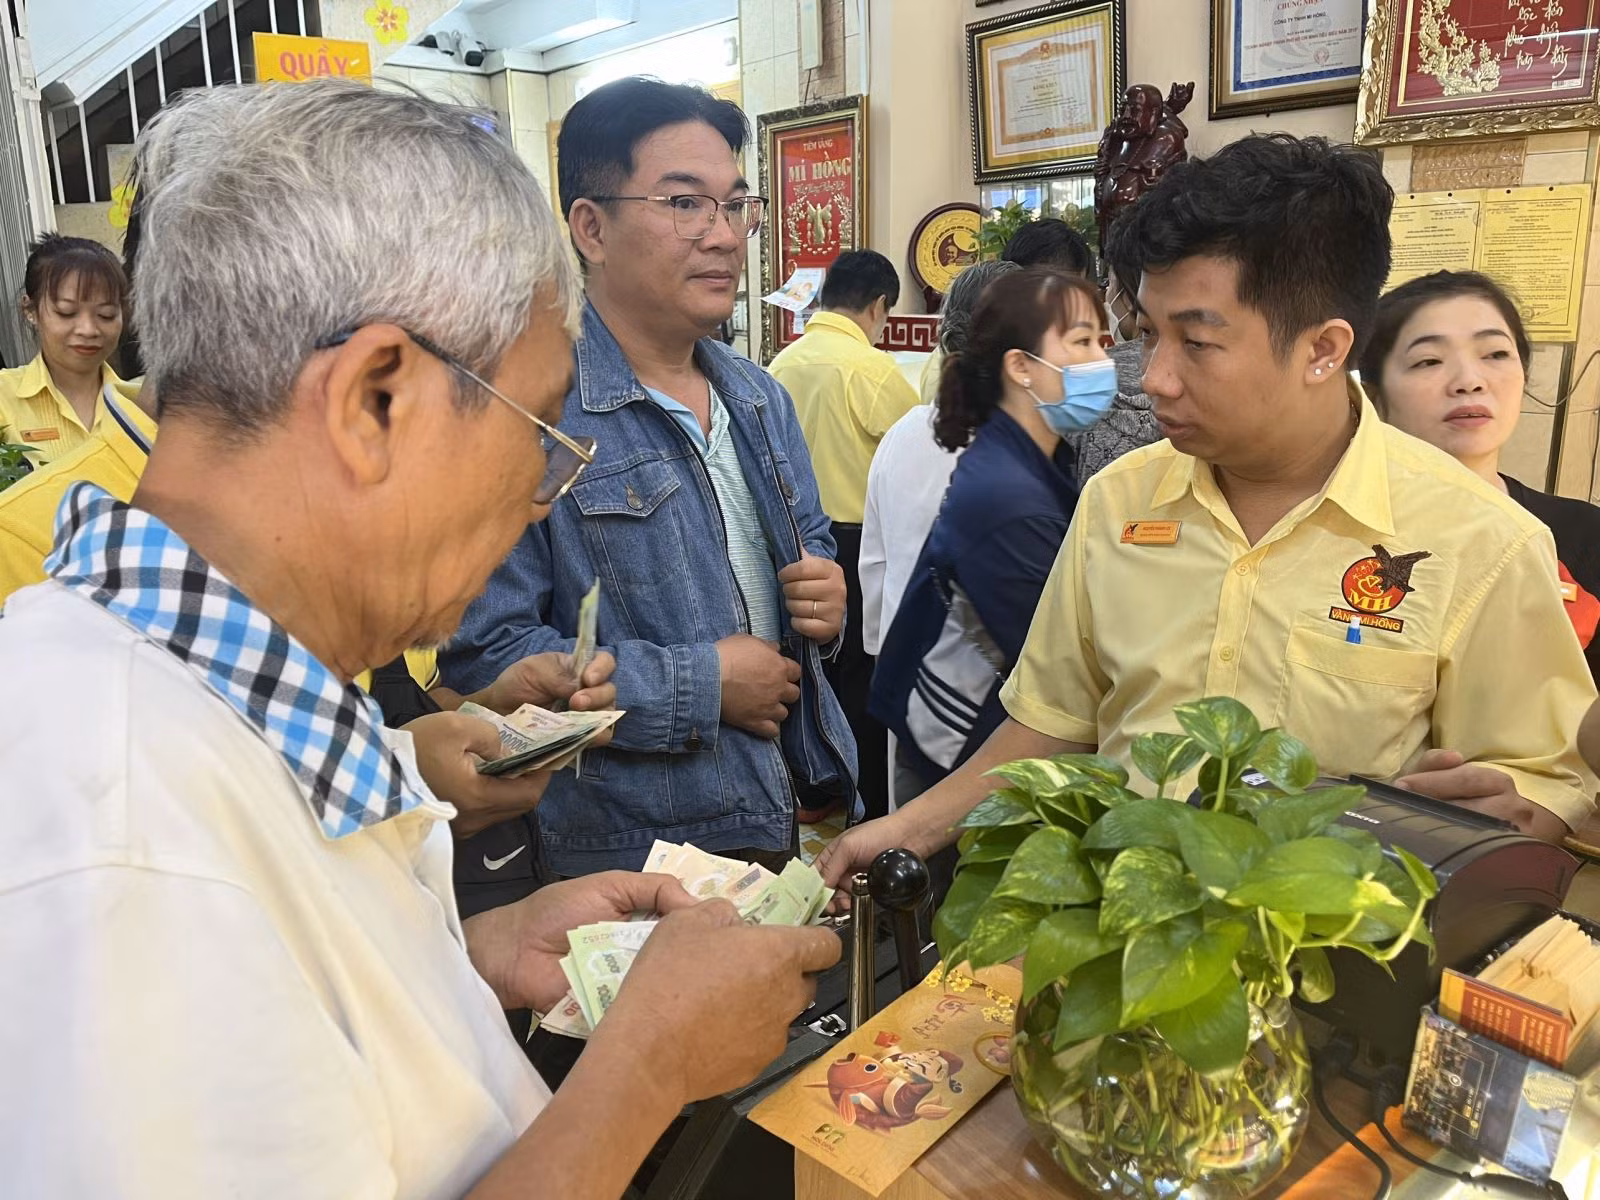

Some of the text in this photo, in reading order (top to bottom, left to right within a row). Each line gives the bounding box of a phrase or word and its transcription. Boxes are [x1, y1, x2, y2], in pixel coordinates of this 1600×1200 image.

[279, 44, 349, 80] QUẦY
[1347, 588, 1393, 611] MH
[1371, 617, 1401, 631] HỒNG
